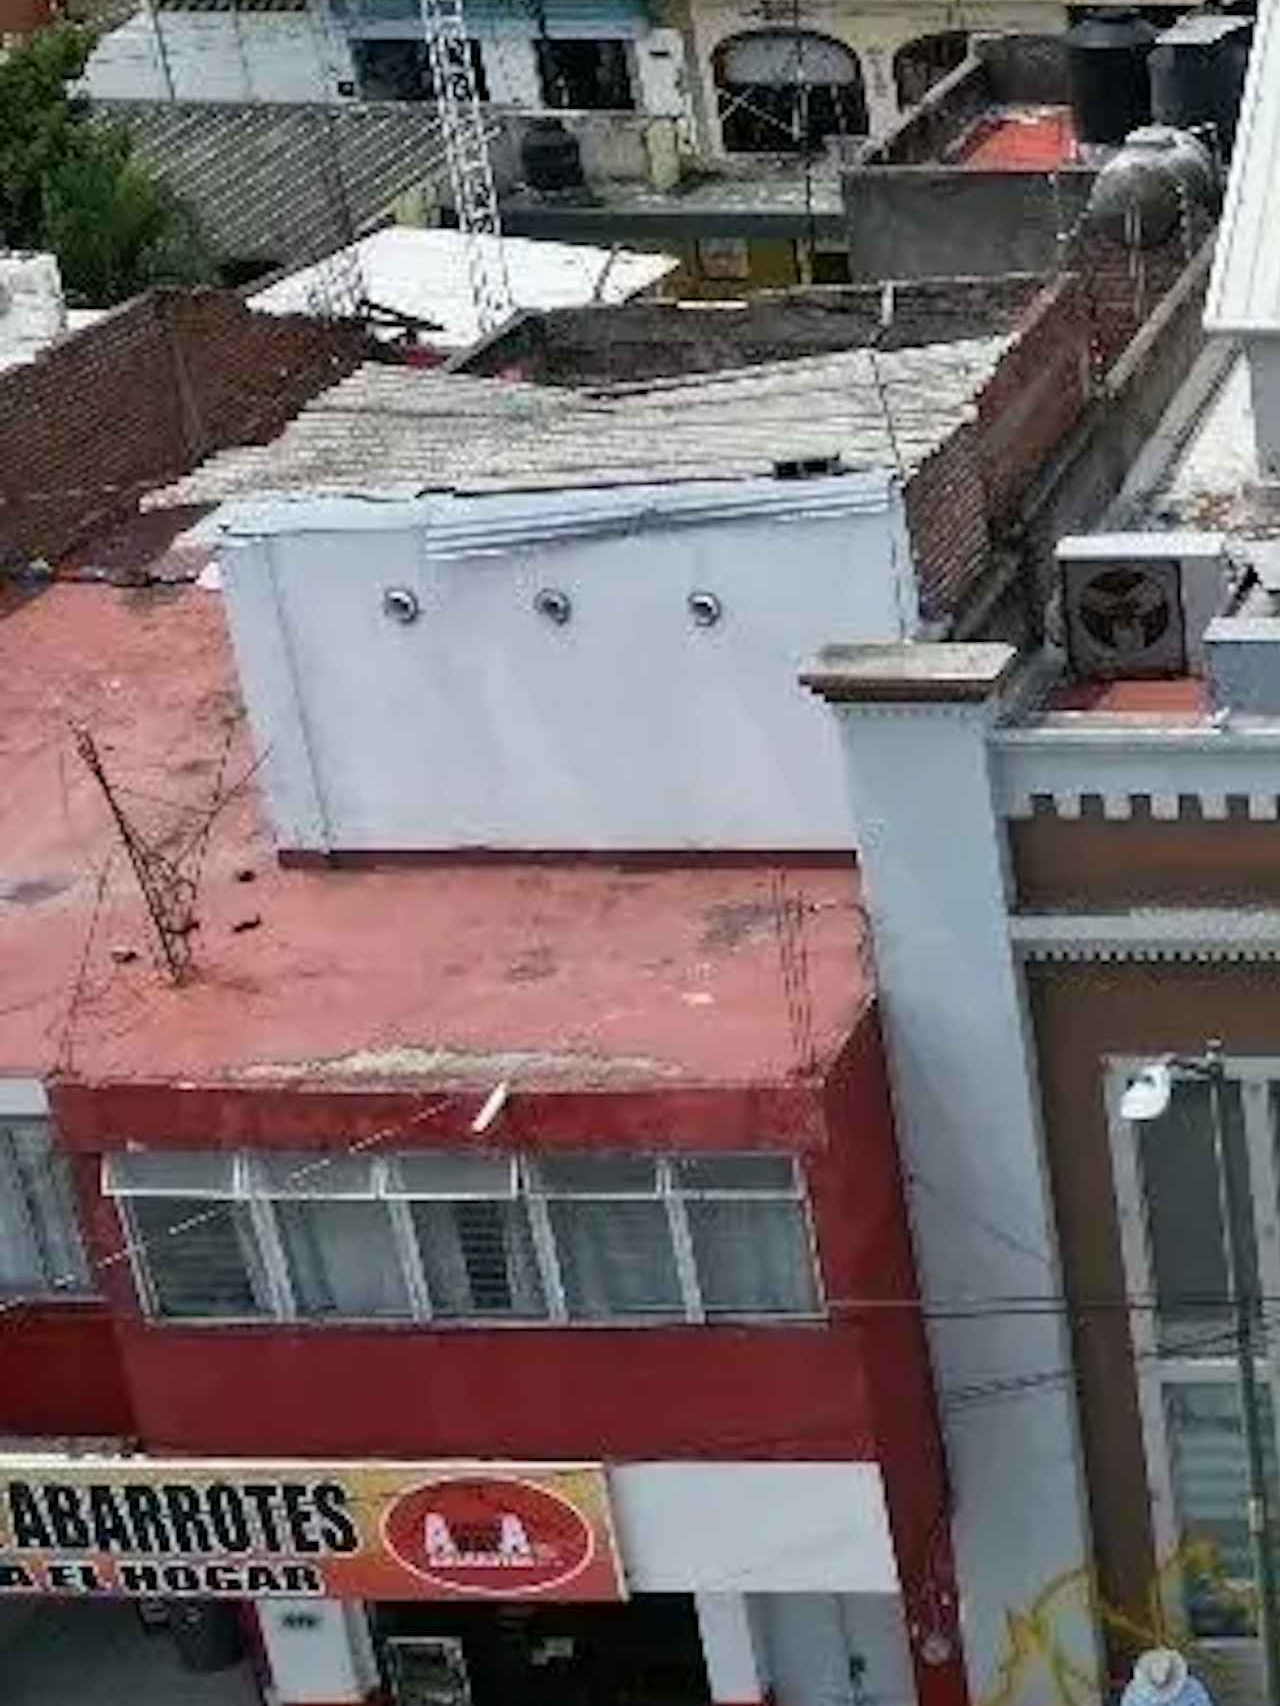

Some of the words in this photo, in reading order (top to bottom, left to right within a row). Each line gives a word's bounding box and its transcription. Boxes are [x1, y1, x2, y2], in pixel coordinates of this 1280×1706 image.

[9, 1480, 359, 1553] ABARROTES
[48, 1565, 97, 1590] EL
[120, 1565, 321, 1591] HOGAR
